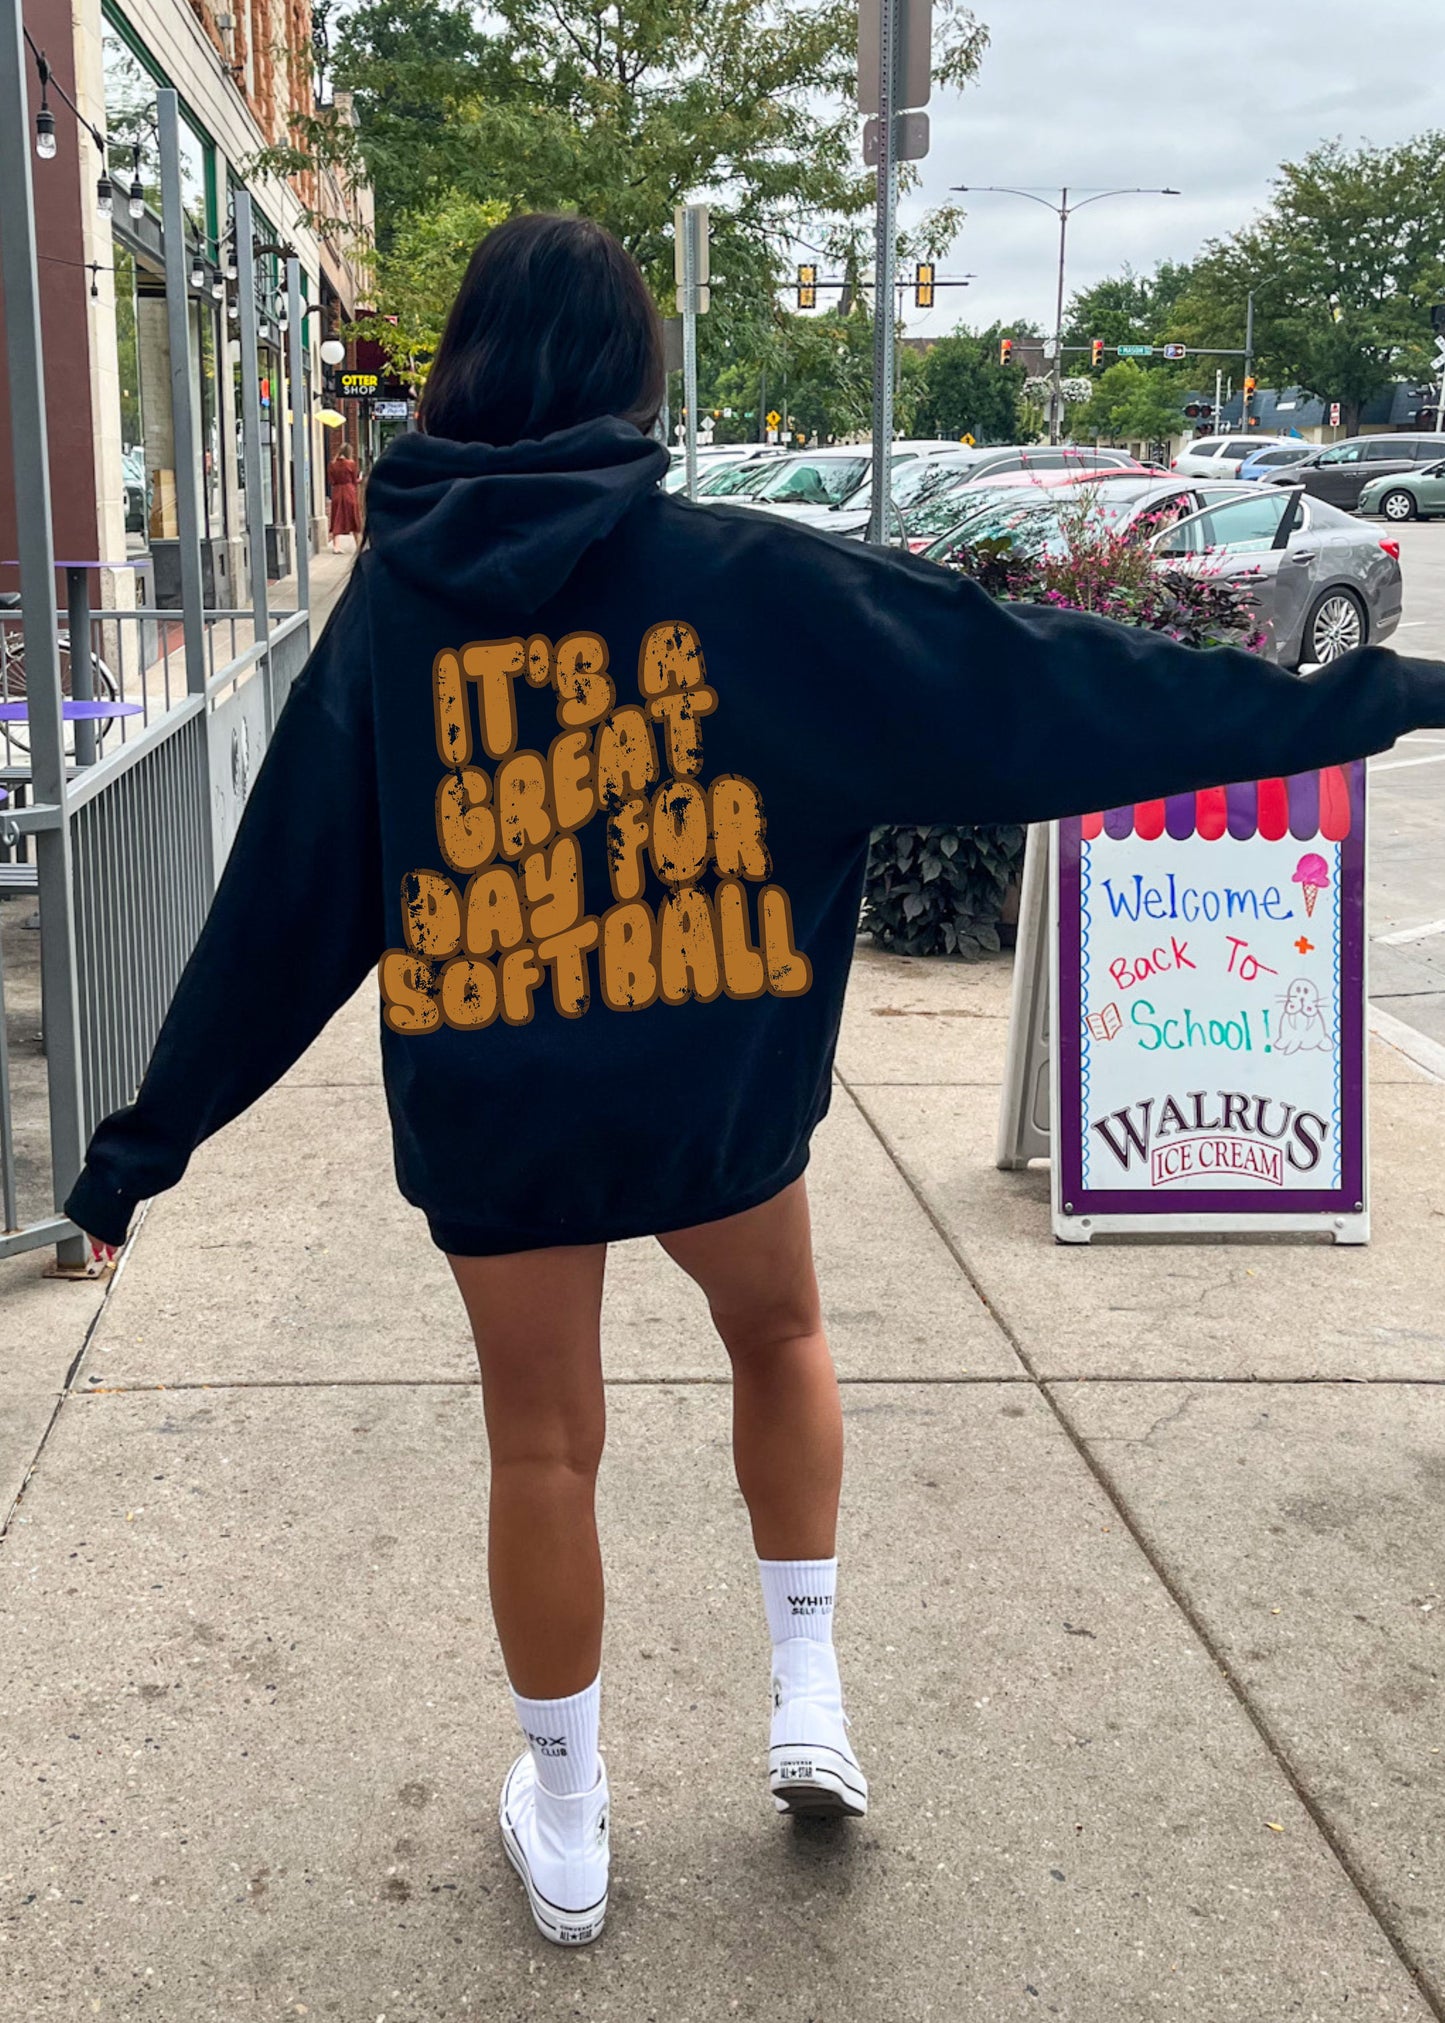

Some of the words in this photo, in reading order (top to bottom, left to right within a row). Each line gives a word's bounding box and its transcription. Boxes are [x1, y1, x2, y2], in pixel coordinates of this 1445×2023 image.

[341, 374, 378, 387] OTTER
[343, 385, 376, 395] SHOP
[433, 631, 616, 768] IT'S
[638, 620, 708, 696] A
[435, 688, 719, 873] GREAT
[401, 833, 584, 961] DAY
[607, 773, 773, 903] FOR
[1101, 873, 1294, 923] Welcome
[379, 878, 813, 1035] SOFTBALL
[1225, 936, 1278, 981] To
[1130, 999, 1272, 1054] School!
[1090, 1089, 1330, 1173] WALRUS
[1156, 1145, 1193, 1179] ICE
[1198, 1140, 1280, 1180] CREAM
[791, 1607, 816, 1616] SELF
[541, 1747, 568, 1757] CLUB
